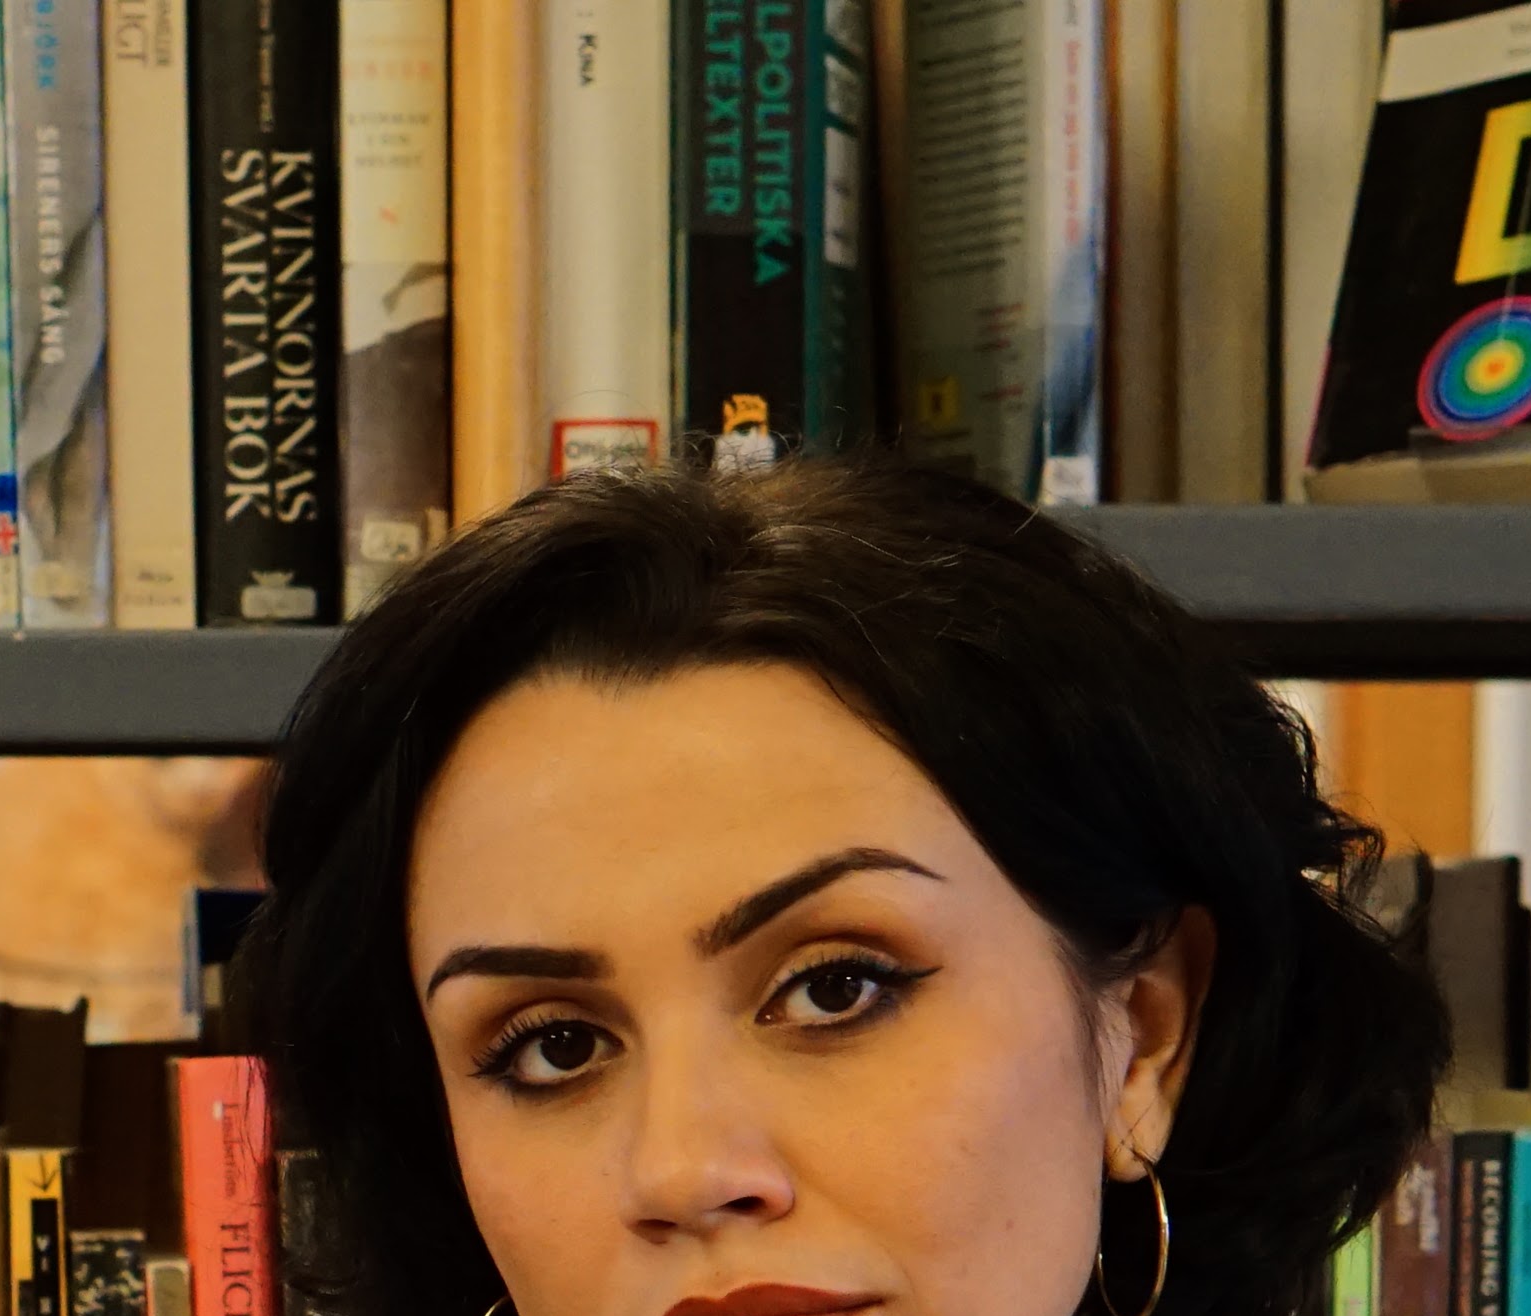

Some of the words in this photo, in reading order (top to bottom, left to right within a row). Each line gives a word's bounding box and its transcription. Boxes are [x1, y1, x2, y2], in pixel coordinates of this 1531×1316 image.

[33, 125, 62, 274] SIRENERS
[220, 150, 269, 380] SVARTA
[37, 284, 70, 366] SÅNG
[270, 150, 318, 524] KVINNORNAS
[222, 396, 269, 524] BOK
[1477, 1159, 1498, 1296] BECOMING
